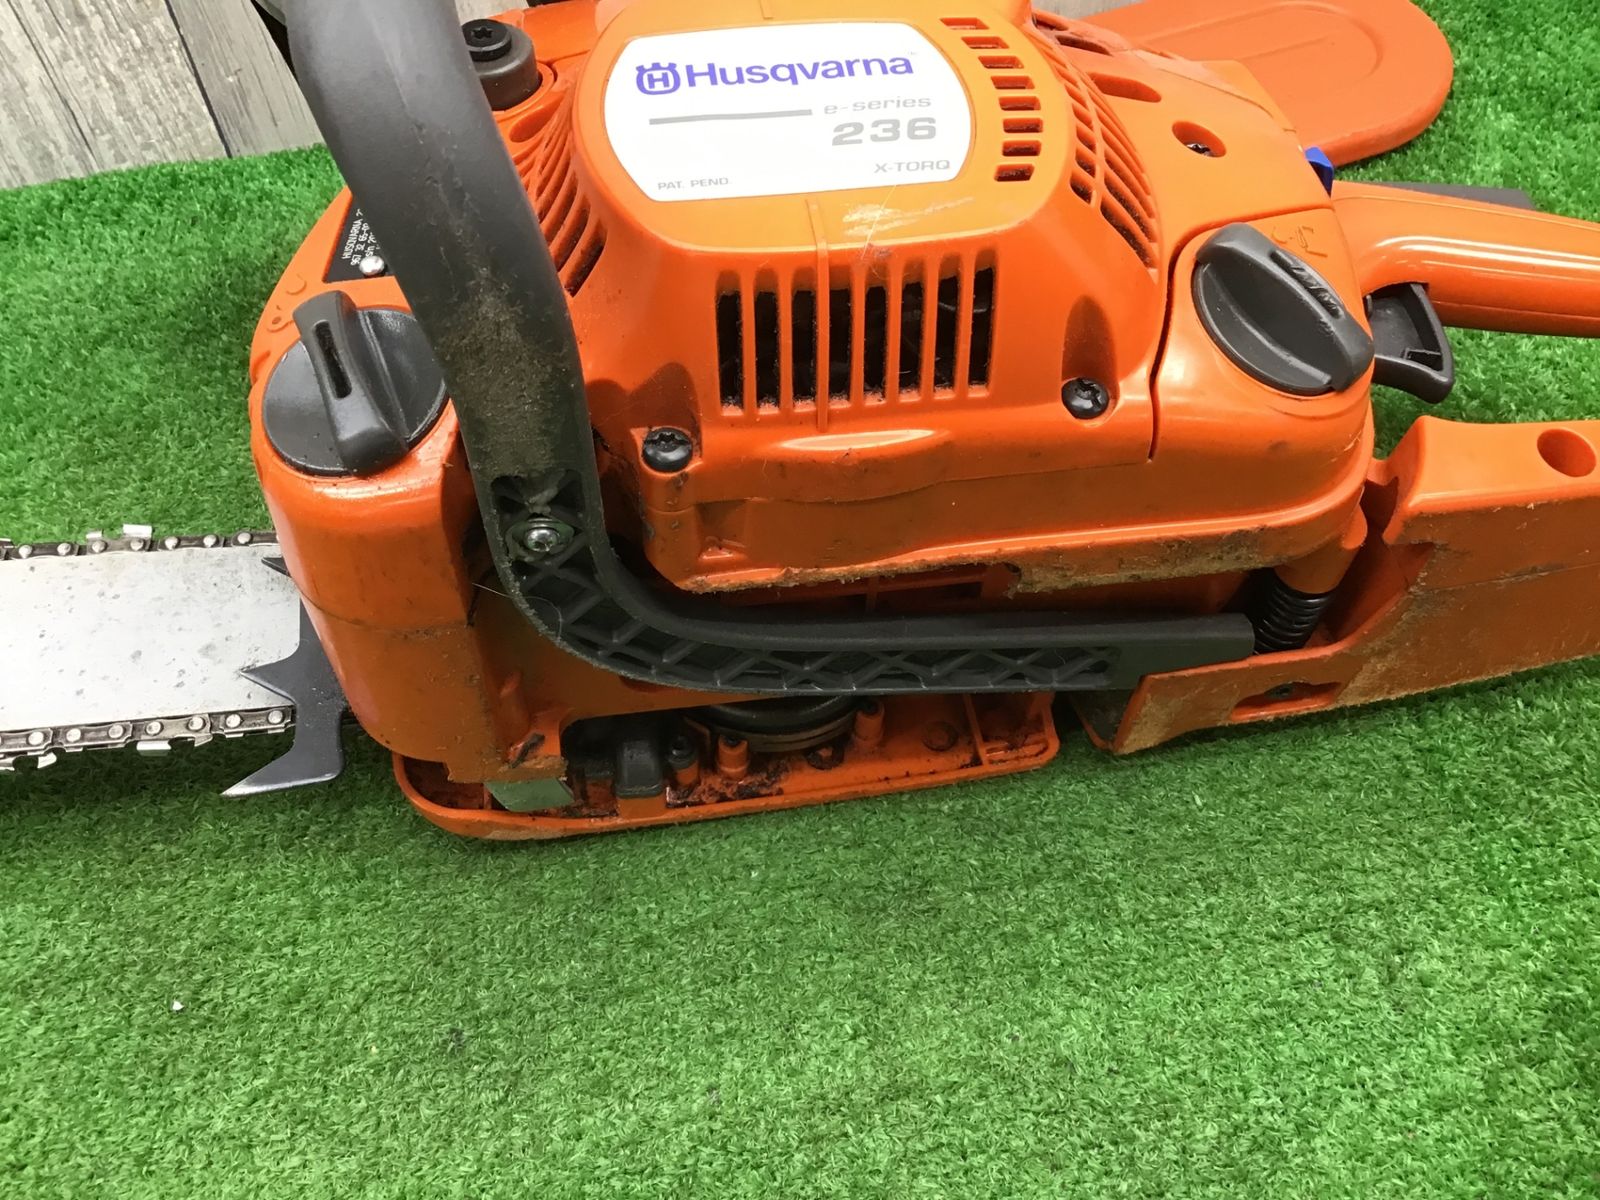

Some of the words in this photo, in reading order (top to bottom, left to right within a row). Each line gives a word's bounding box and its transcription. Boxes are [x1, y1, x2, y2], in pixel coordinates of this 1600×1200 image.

[685, 57, 914, 88] Husqvarna
[823, 96, 933, 116] e-series
[831, 116, 937, 147] 236
[873, 159, 951, 174] X-TORQ
[341, 218, 364, 260] HUSQVARNA
